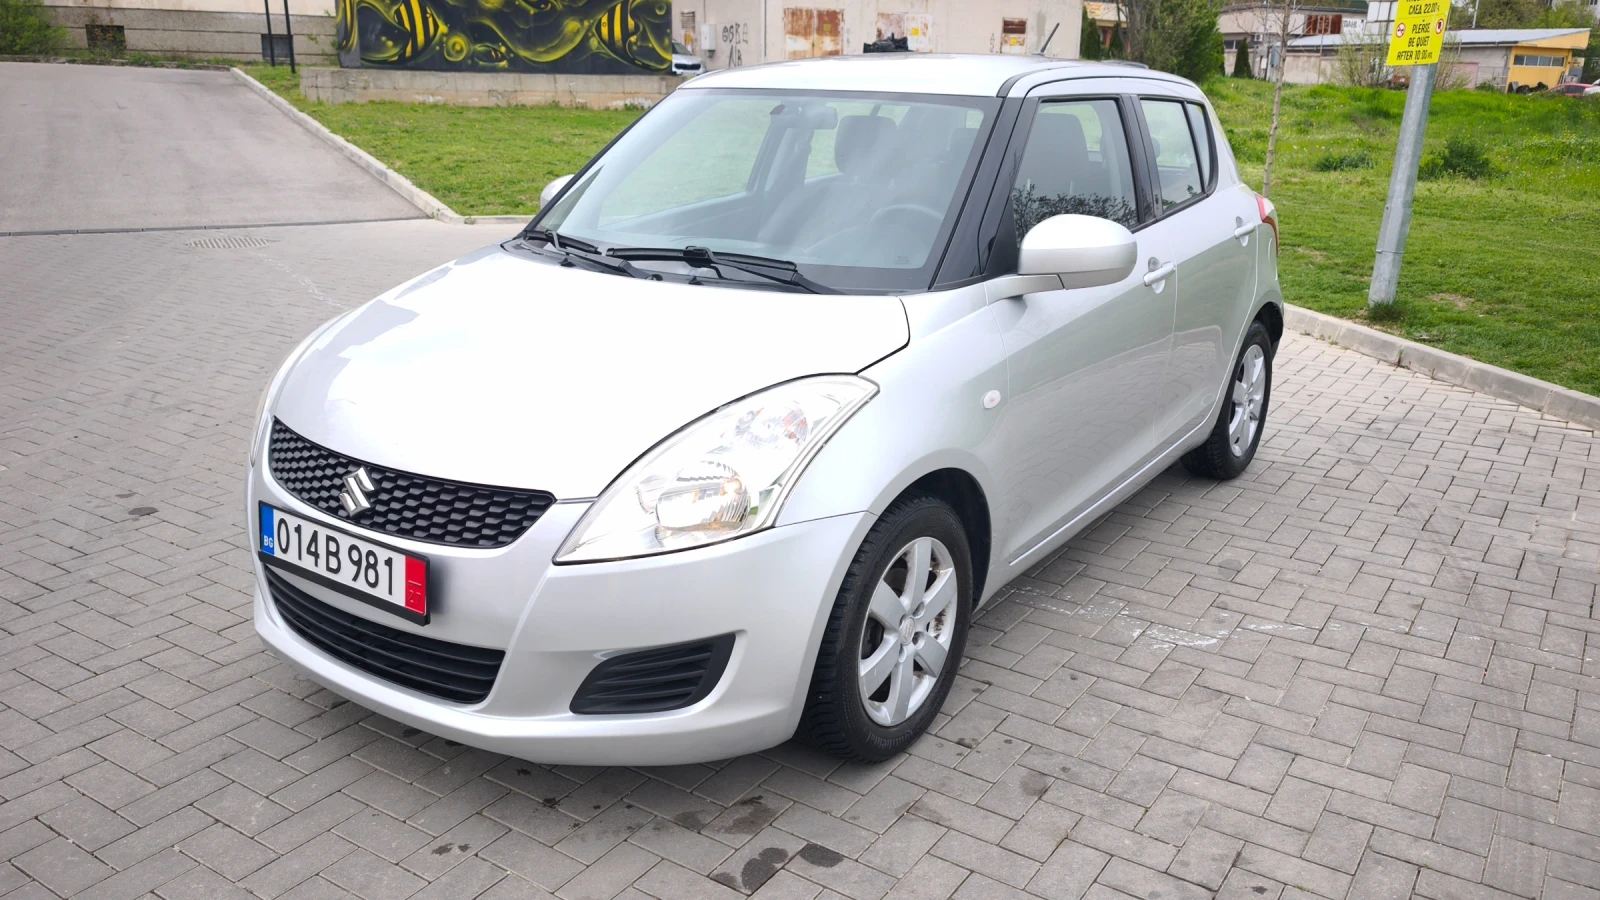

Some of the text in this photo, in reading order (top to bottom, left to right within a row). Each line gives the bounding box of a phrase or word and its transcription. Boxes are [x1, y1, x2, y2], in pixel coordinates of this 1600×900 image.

[1412, 23, 1430, 34] PLEASE
[1408, 36, 1430, 48] BE QUIET
[1396, 51, 1413, 61] AFTER
[264, 535, 274, 548] BG
